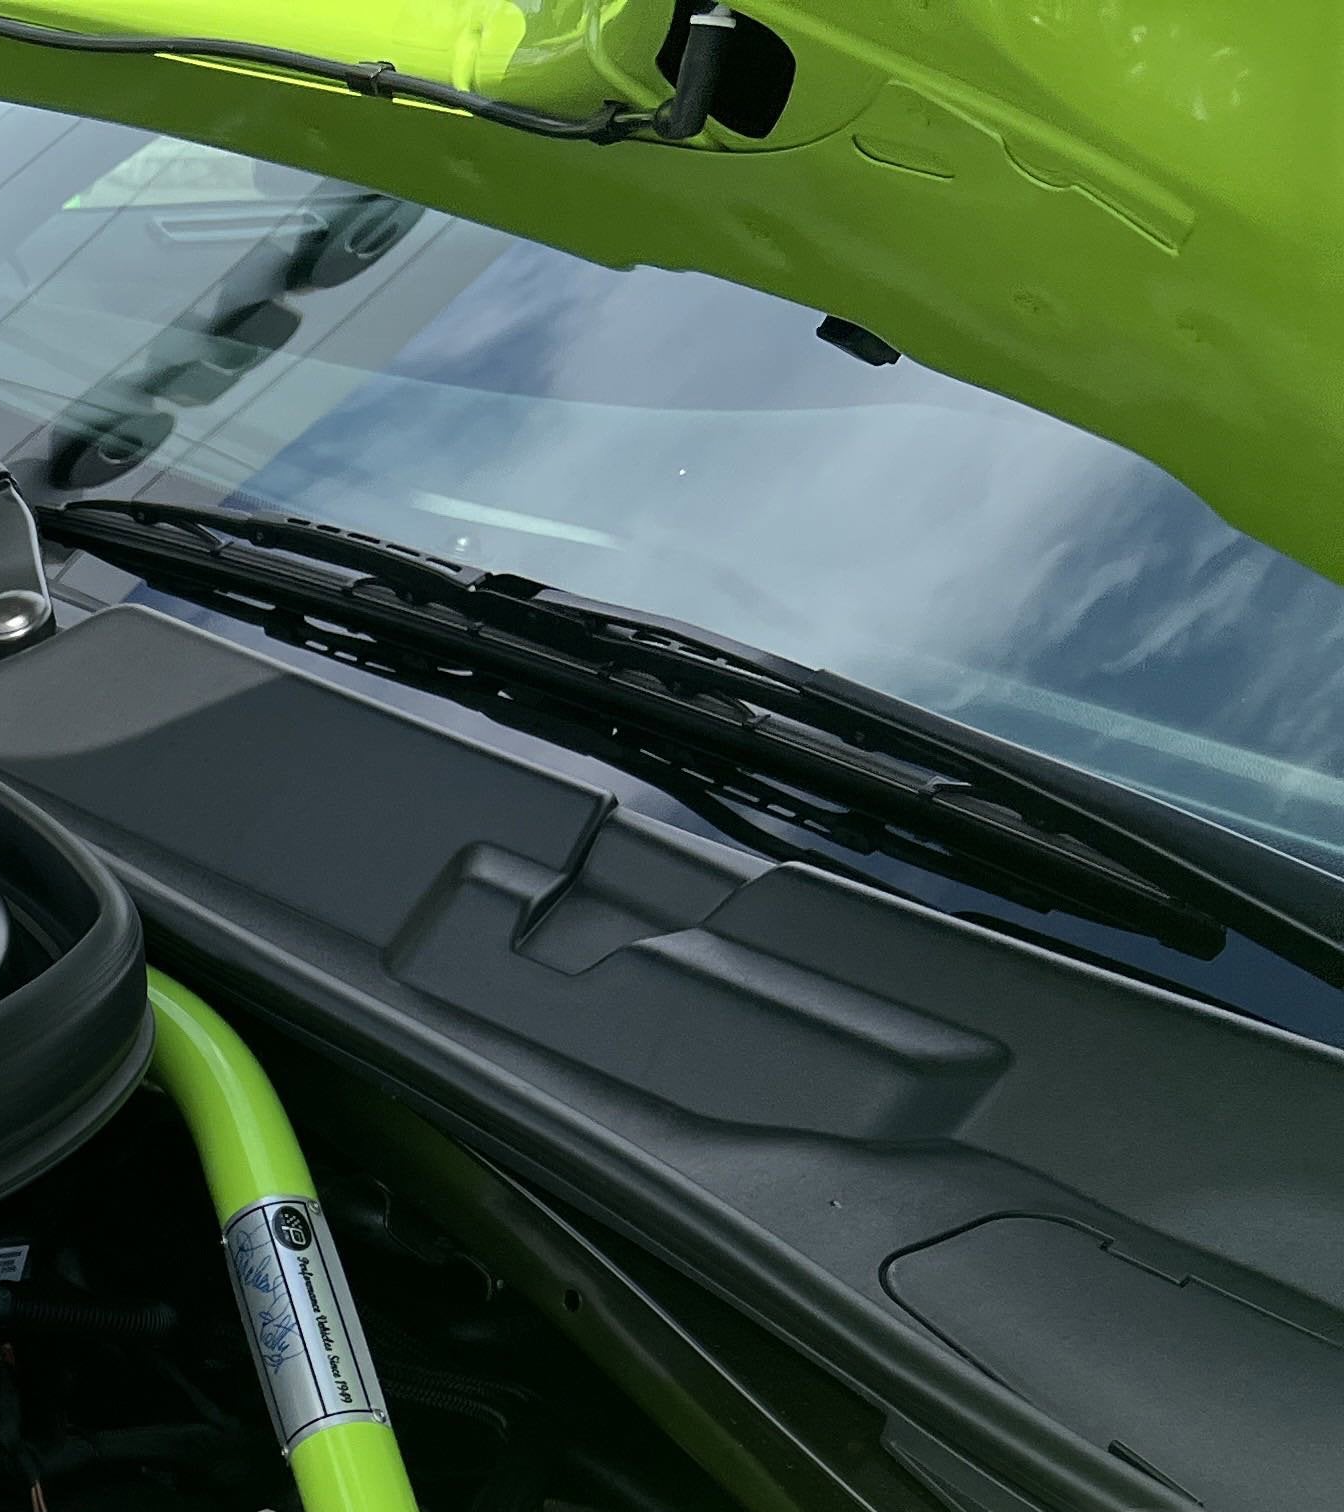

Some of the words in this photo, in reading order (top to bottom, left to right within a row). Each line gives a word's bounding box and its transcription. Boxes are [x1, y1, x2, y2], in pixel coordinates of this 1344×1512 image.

[297, 1256, 320, 1313] Performance
[316, 1315, 334, 1351] Vehicles
[327, 1353, 342, 1378] Since
